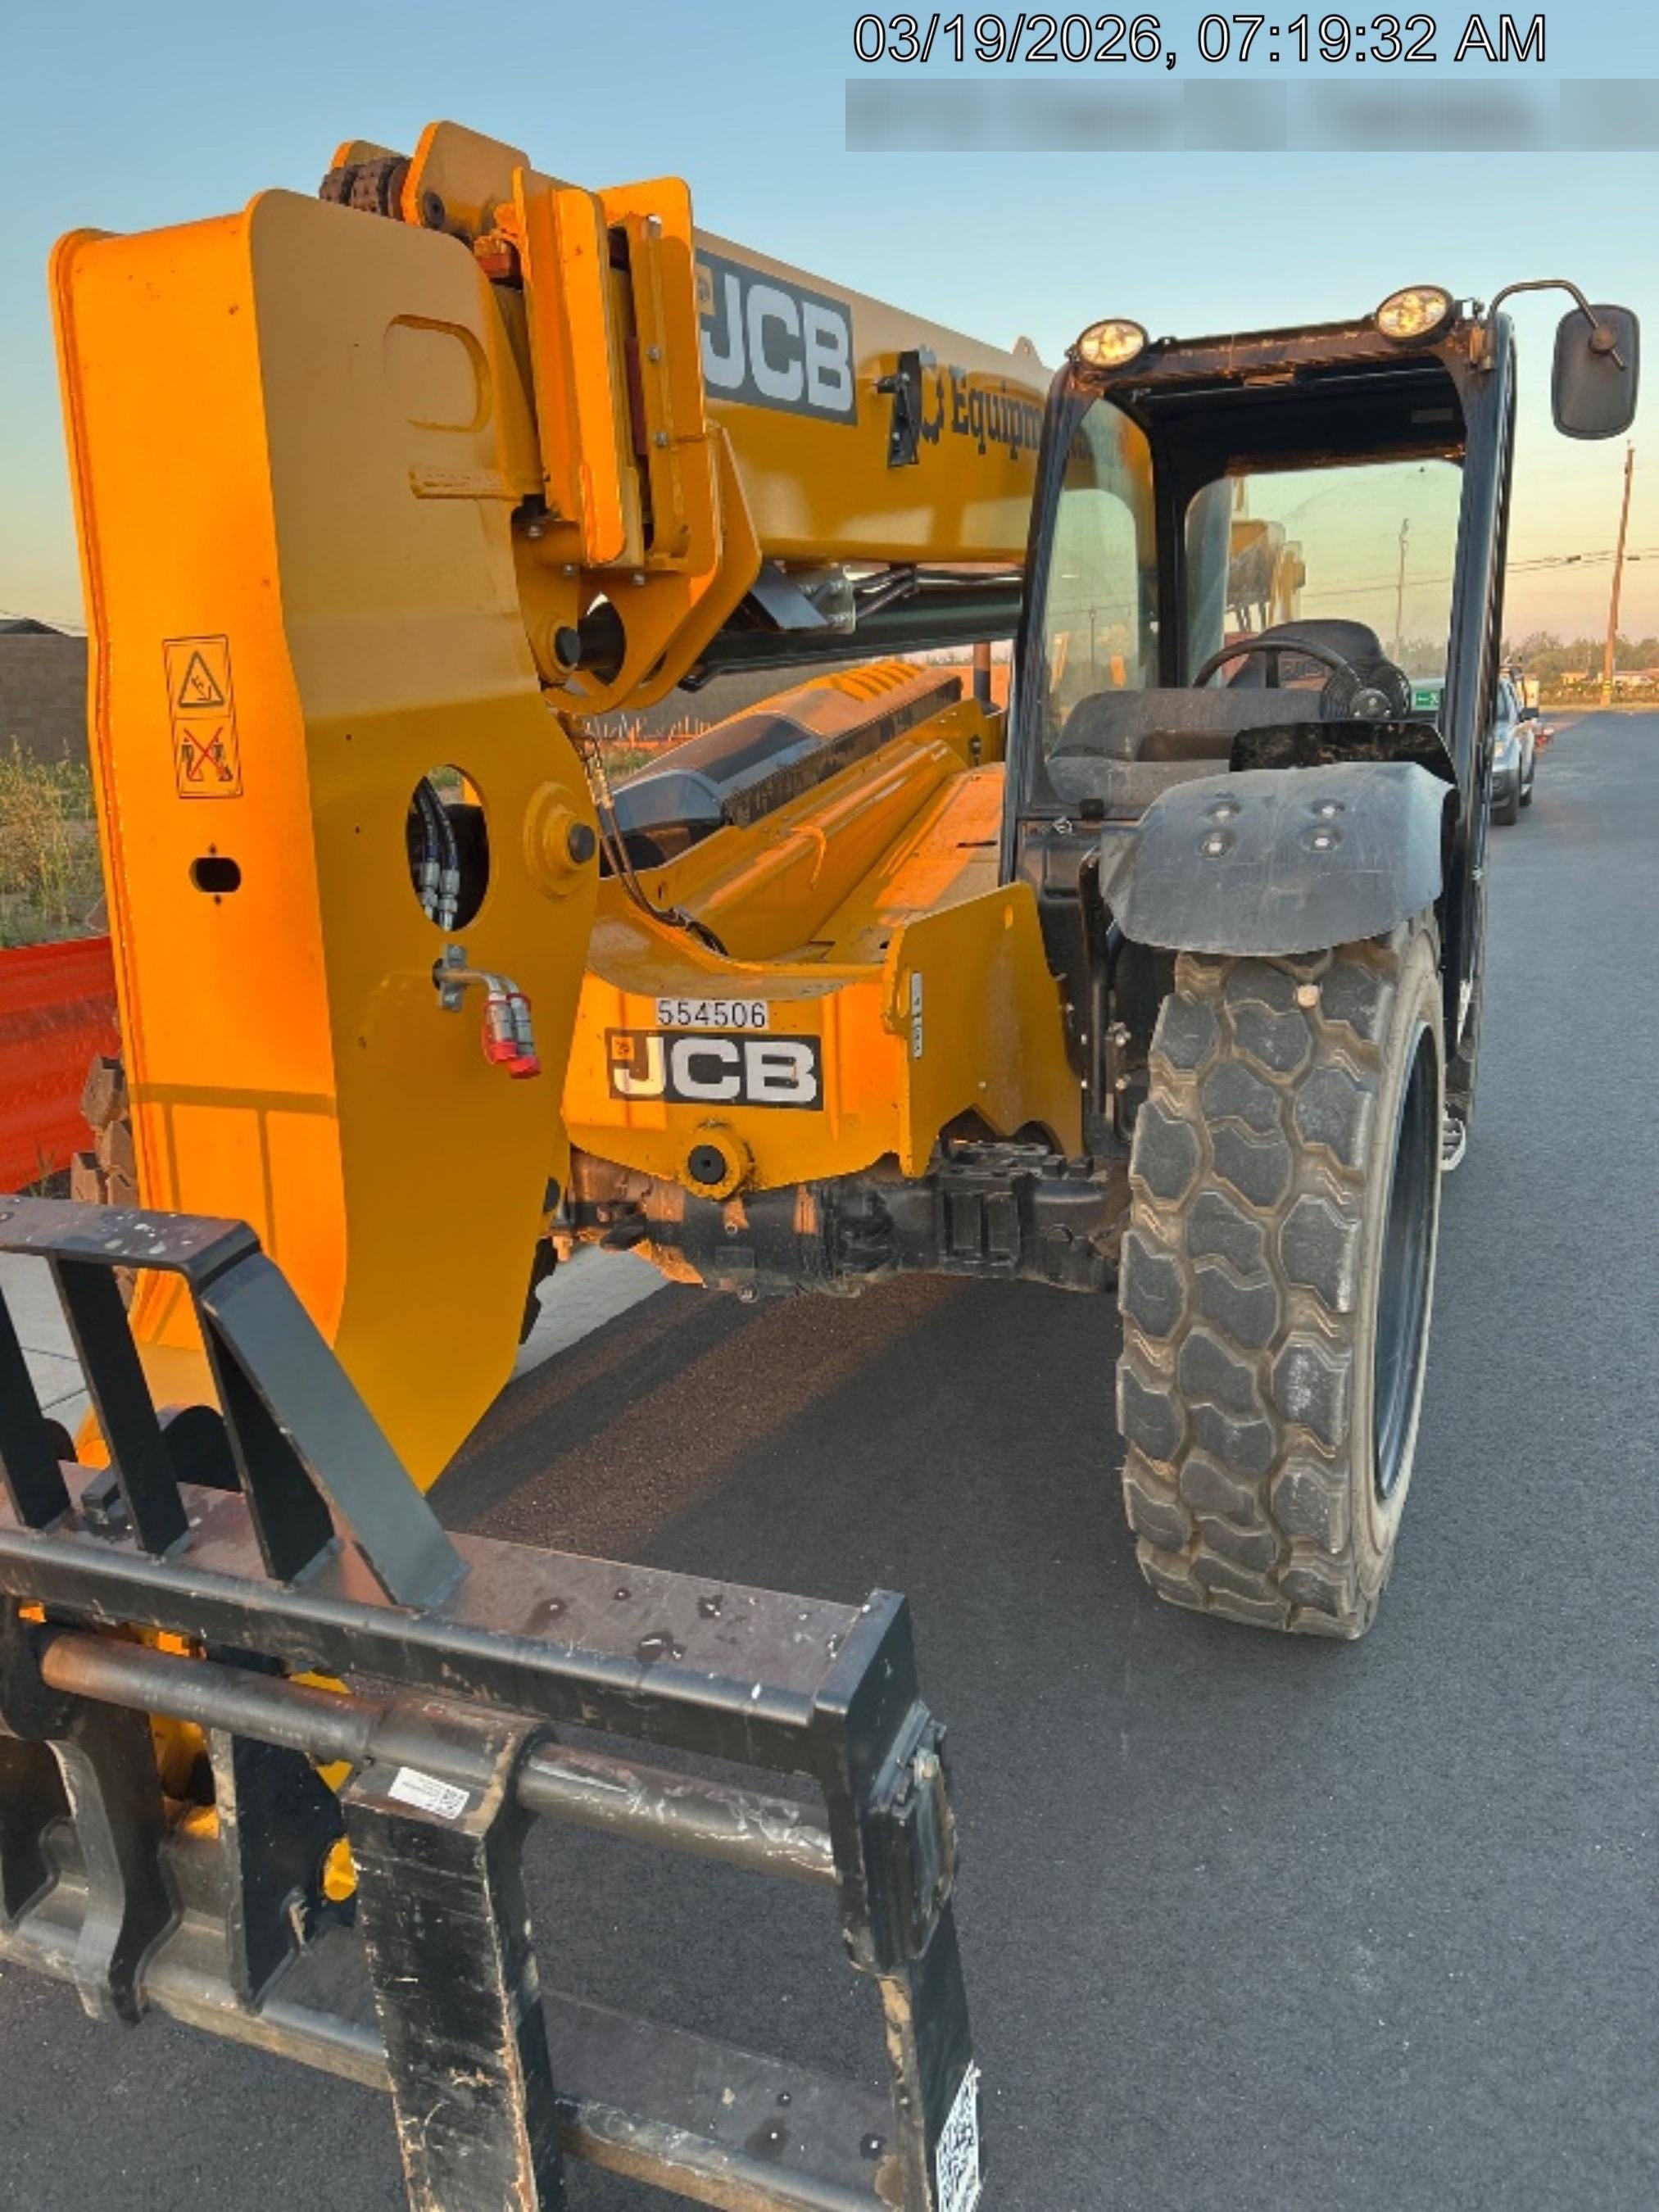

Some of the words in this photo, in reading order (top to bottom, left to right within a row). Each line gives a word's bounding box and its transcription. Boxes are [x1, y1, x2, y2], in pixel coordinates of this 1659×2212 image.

[701, 273, 853, 411] JCB
[949, 364, 1043, 460] Equipm
[658, 1000, 765, 1027] 554506
[614, 1036, 818, 1102] JCB
